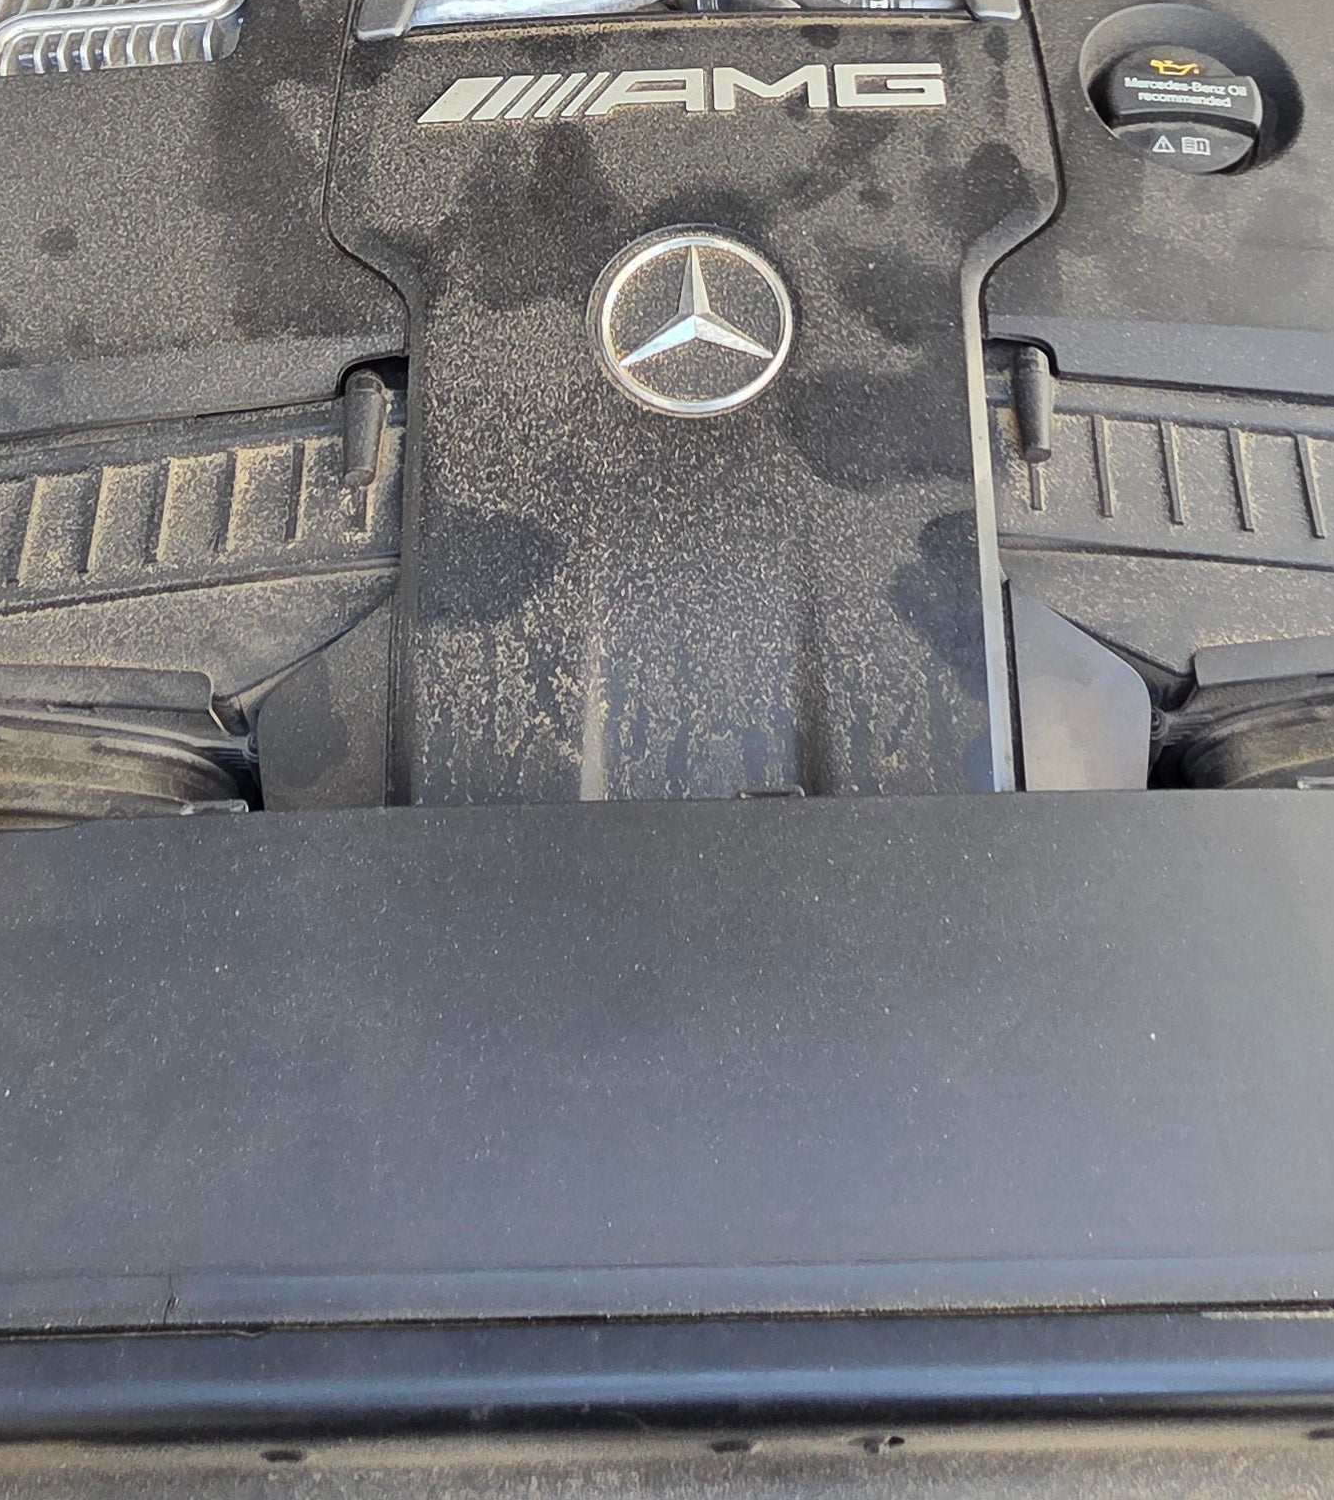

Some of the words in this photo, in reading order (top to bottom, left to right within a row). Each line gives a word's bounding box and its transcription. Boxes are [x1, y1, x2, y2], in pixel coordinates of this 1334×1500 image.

[586, 61, 947, 117] AMG
[1123, 77, 1227, 96] Mercedes-Benz
[1227, 85, 1248, 97] Oil
[1137, 91, 1233, 108] recommended
